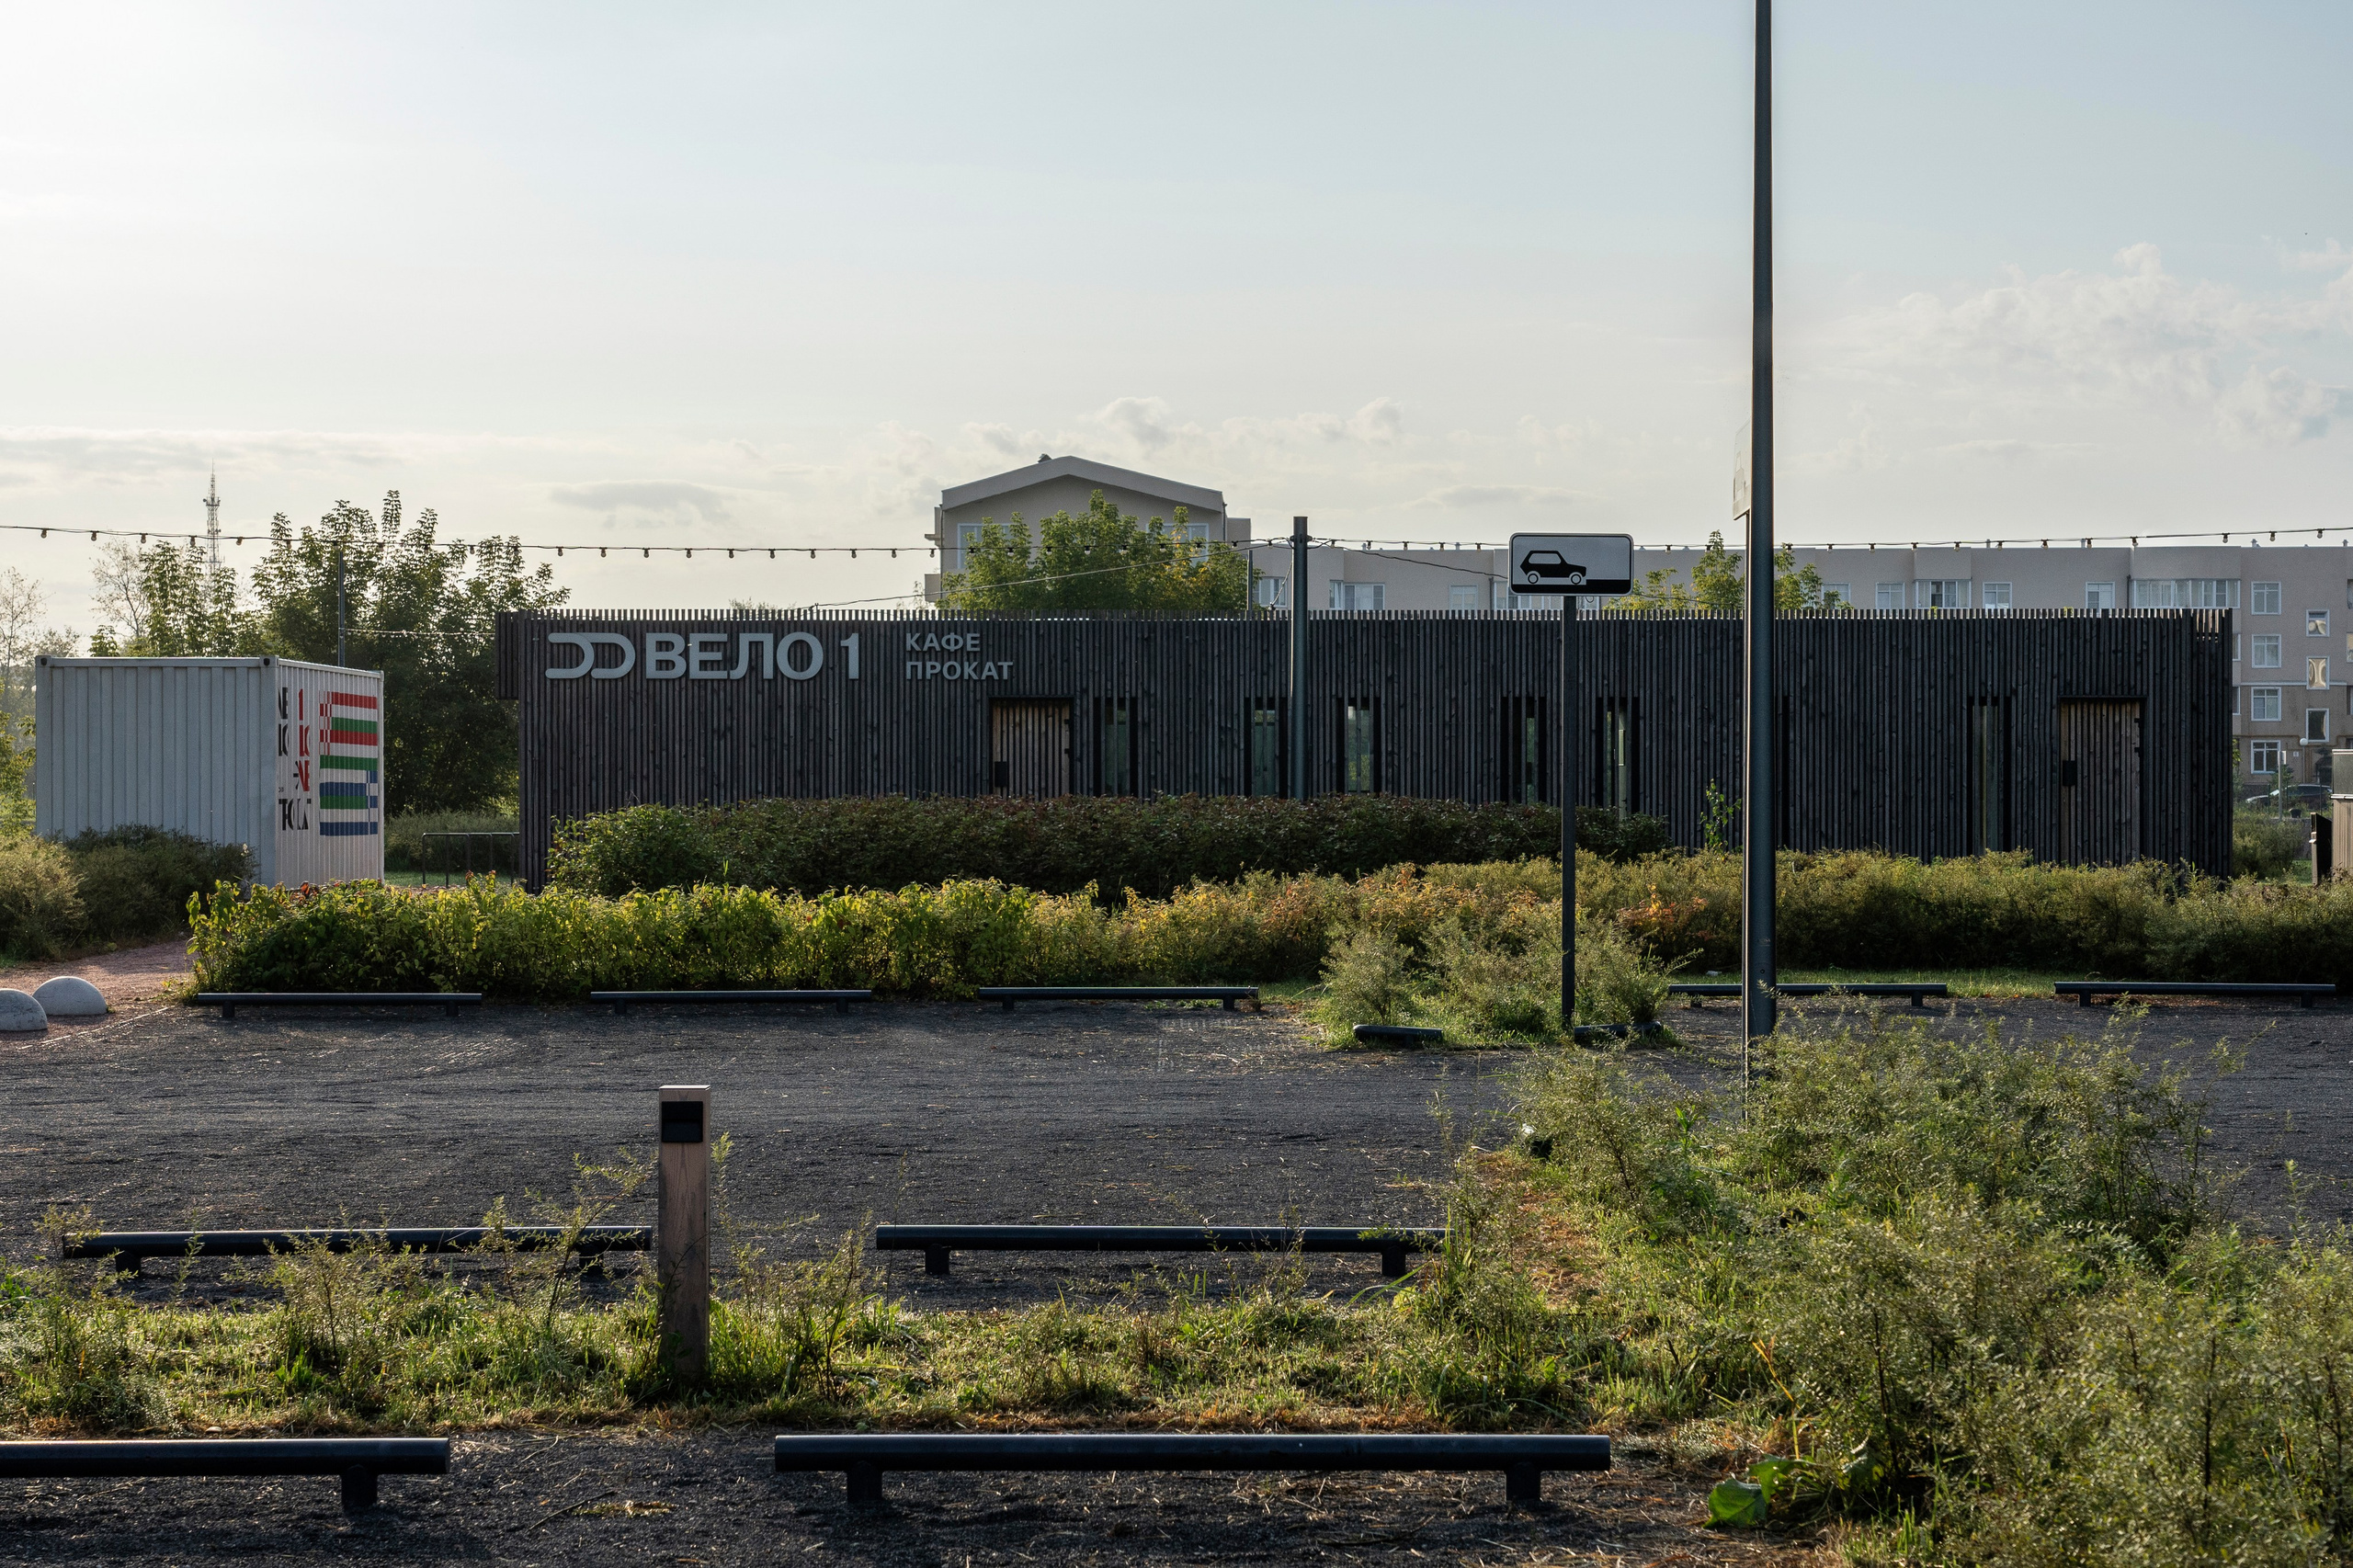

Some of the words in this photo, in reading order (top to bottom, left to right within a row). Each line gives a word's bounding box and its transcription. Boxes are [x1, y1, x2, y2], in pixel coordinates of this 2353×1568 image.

[905, 631, 981, 652] КАФЕ
[646, 631, 824, 680] ВЕЛО
[840, 632, 859, 679] 1
[905, 661, 1014, 680] ПРОКАТ
